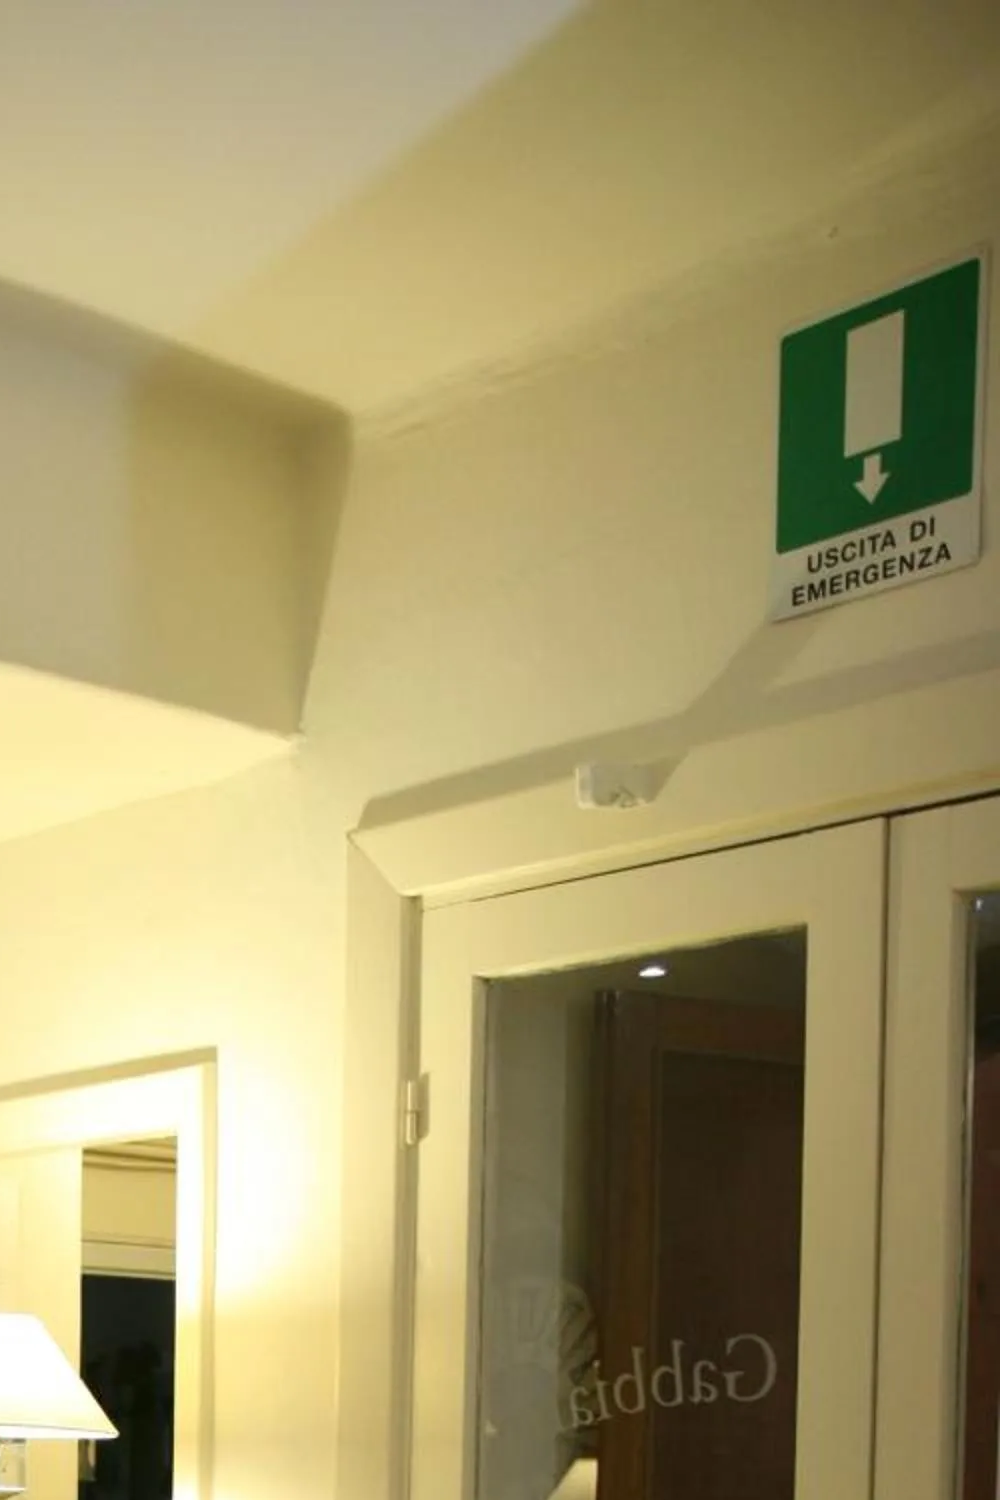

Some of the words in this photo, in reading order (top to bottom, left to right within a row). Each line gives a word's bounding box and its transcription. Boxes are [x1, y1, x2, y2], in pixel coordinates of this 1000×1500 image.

[792, 543, 952, 606] EMERGENZA
[807, 530, 896, 573] USCITA
[910, 516, 935, 542] DI
